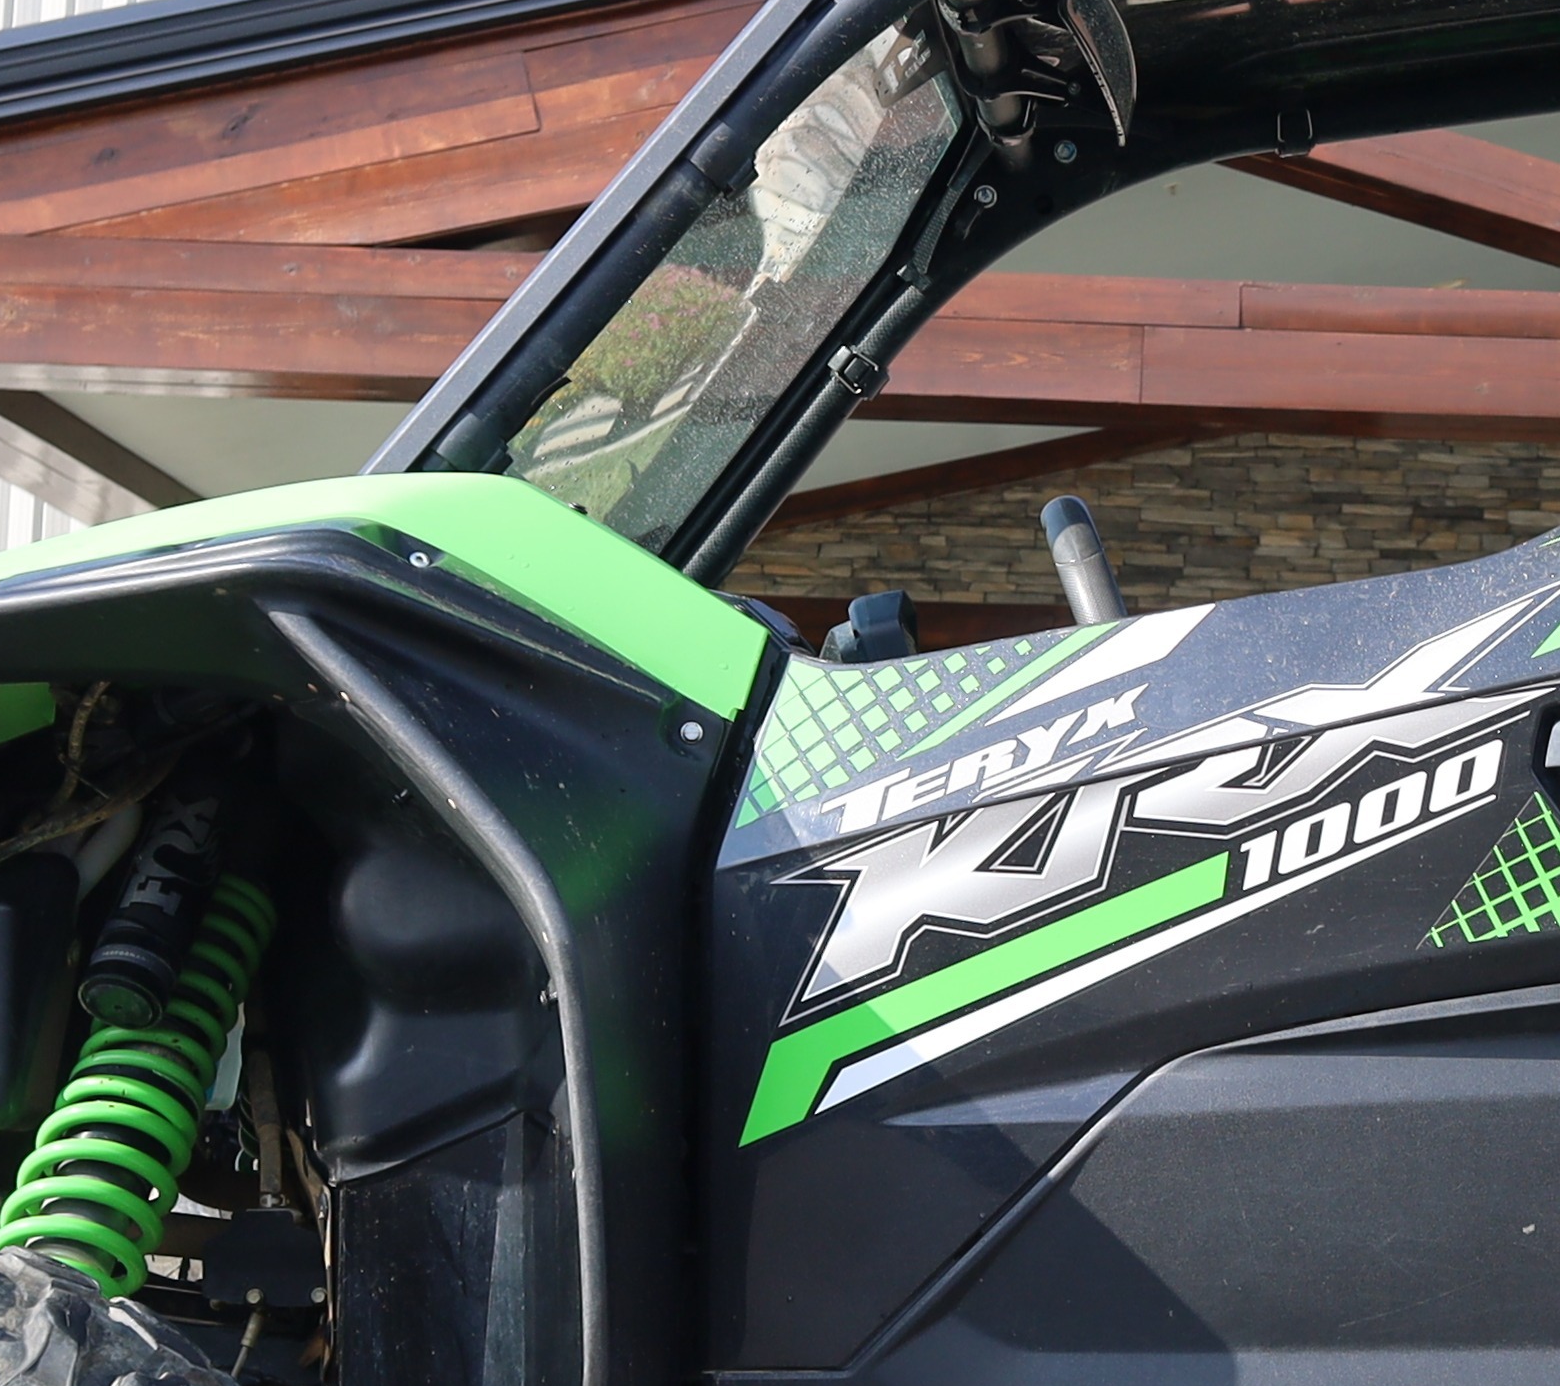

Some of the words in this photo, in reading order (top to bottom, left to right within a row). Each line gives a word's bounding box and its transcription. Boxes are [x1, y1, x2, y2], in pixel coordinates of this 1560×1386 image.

[820, 682, 1149, 835] TERYX
[1241, 739, 1504, 891] 1000
[119, 795, 222, 917] FOX
